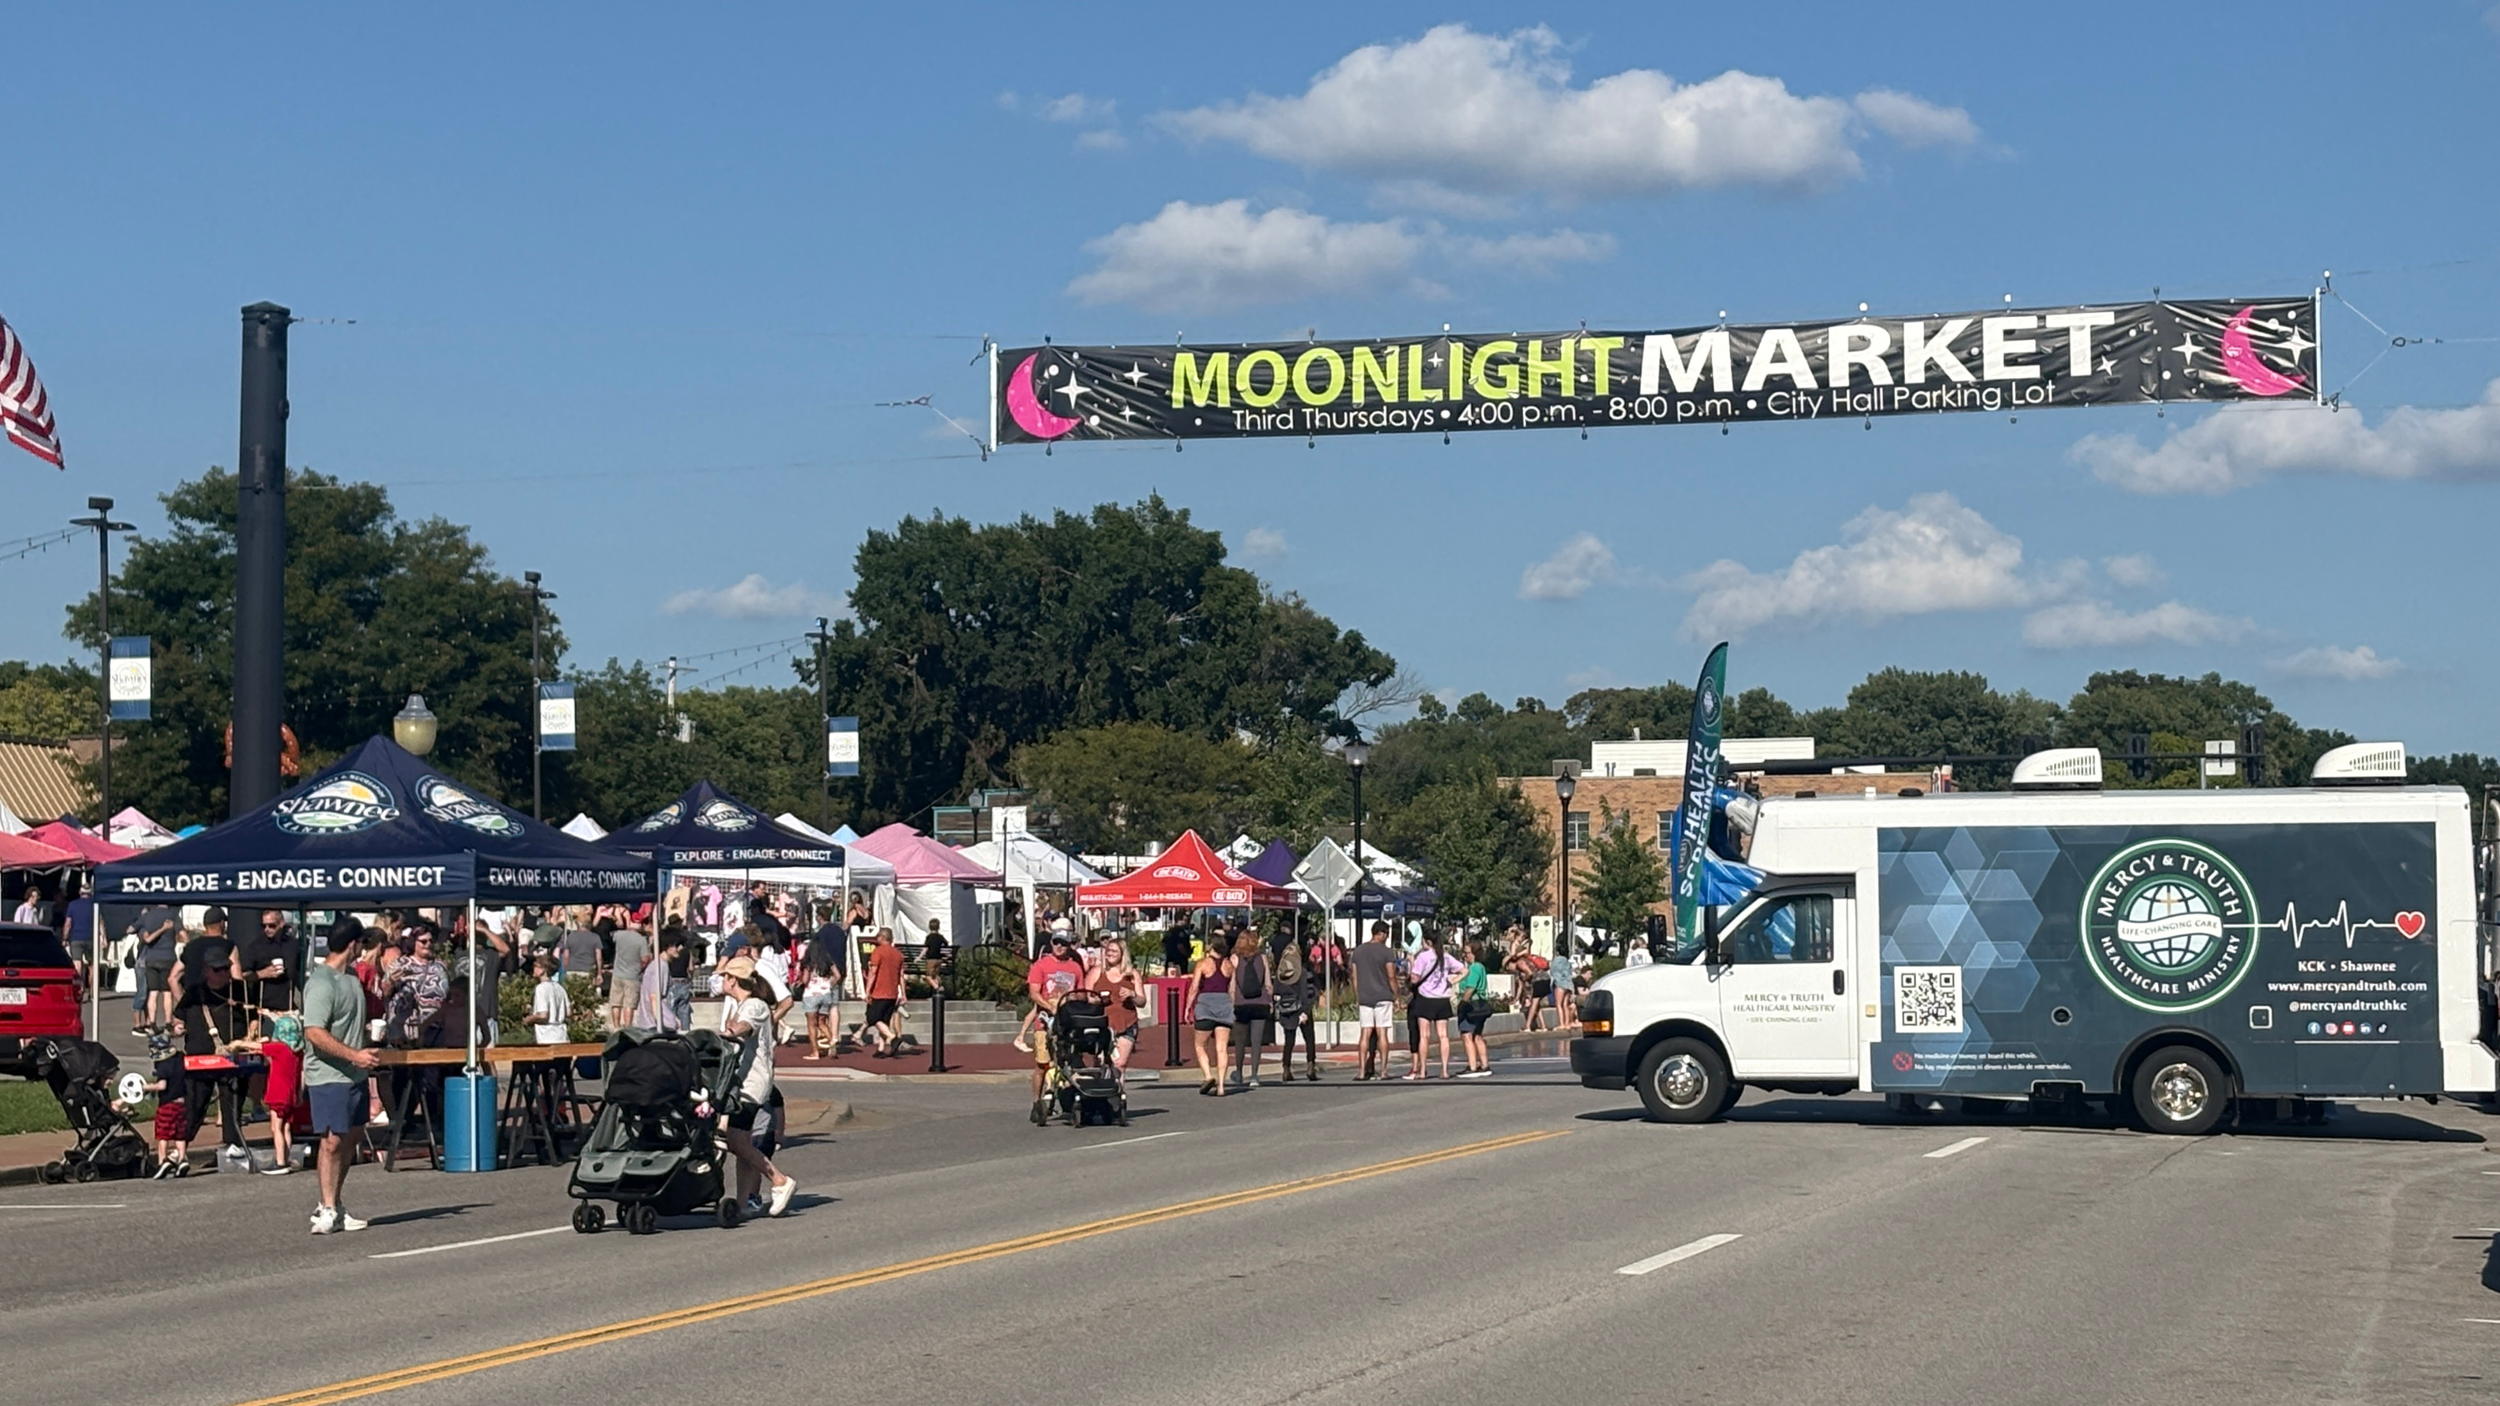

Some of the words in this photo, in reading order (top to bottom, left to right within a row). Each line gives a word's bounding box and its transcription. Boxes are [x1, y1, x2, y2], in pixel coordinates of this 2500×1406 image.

[1171, 336, 1625, 409] MOONLIGHT
[1639, 311, 2115, 395] MARKET
[1232, 409, 1294, 430] Third
[1301, 406, 1435, 431] Thursdays
[1457, 403, 1514, 425] 4:00
[1521, 405, 1584, 428] p.m.
[1609, 396, 1667, 419] 8:00
[1676, 398, 1739, 424] p.m.
[1767, 389, 1820, 419] City
[1832, 385, 1885, 412] Hall
[1894, 381, 2001, 412] Parking
[2010, 379, 2055, 405] Lot
[1684, 741, 1704, 840] HEALTH
[674, 849, 724, 862] EXPLORE
[732, 848, 776, 861] ENGAGE
[781, 848, 831, 861] CONNECT
[122, 873, 219, 893] EXPLORE
[238, 867, 326, 891] ENGAGE
[338, 866, 445, 888] CONNECT
[489, 867, 542, 886] EXPLORE
[550, 868, 593, 888] ENGAGE
[598, 871, 646, 889] CONNECT
[2097, 854, 2156, 917] MERCY
[2162, 854, 2174, 866] &
[2181, 854, 2242, 916] TRUTH
[2122, 920, 2192, 935] LIFE-CHANGING
[2195, 919, 2218, 929] CARE
[2101, 936, 2180, 994] HEALTHCARE
[2187, 935, 2241, 992] MINISTRY
[2298, 960, 2326, 971] KCK
[2340, 959, 2396, 972] Shawnee
[2268, 980, 2427, 994] www.mercyandtruth.com
[1744, 994, 1779, 1002] MERCY
[1790, 994, 1824, 1002] TRUTH
[2289, 1000, 2407, 1013] @mercyandtruthkc
[1733, 1004, 1790, 1012] HEALTHCARE
[1793, 1004, 1835, 1012] MINISTRY
